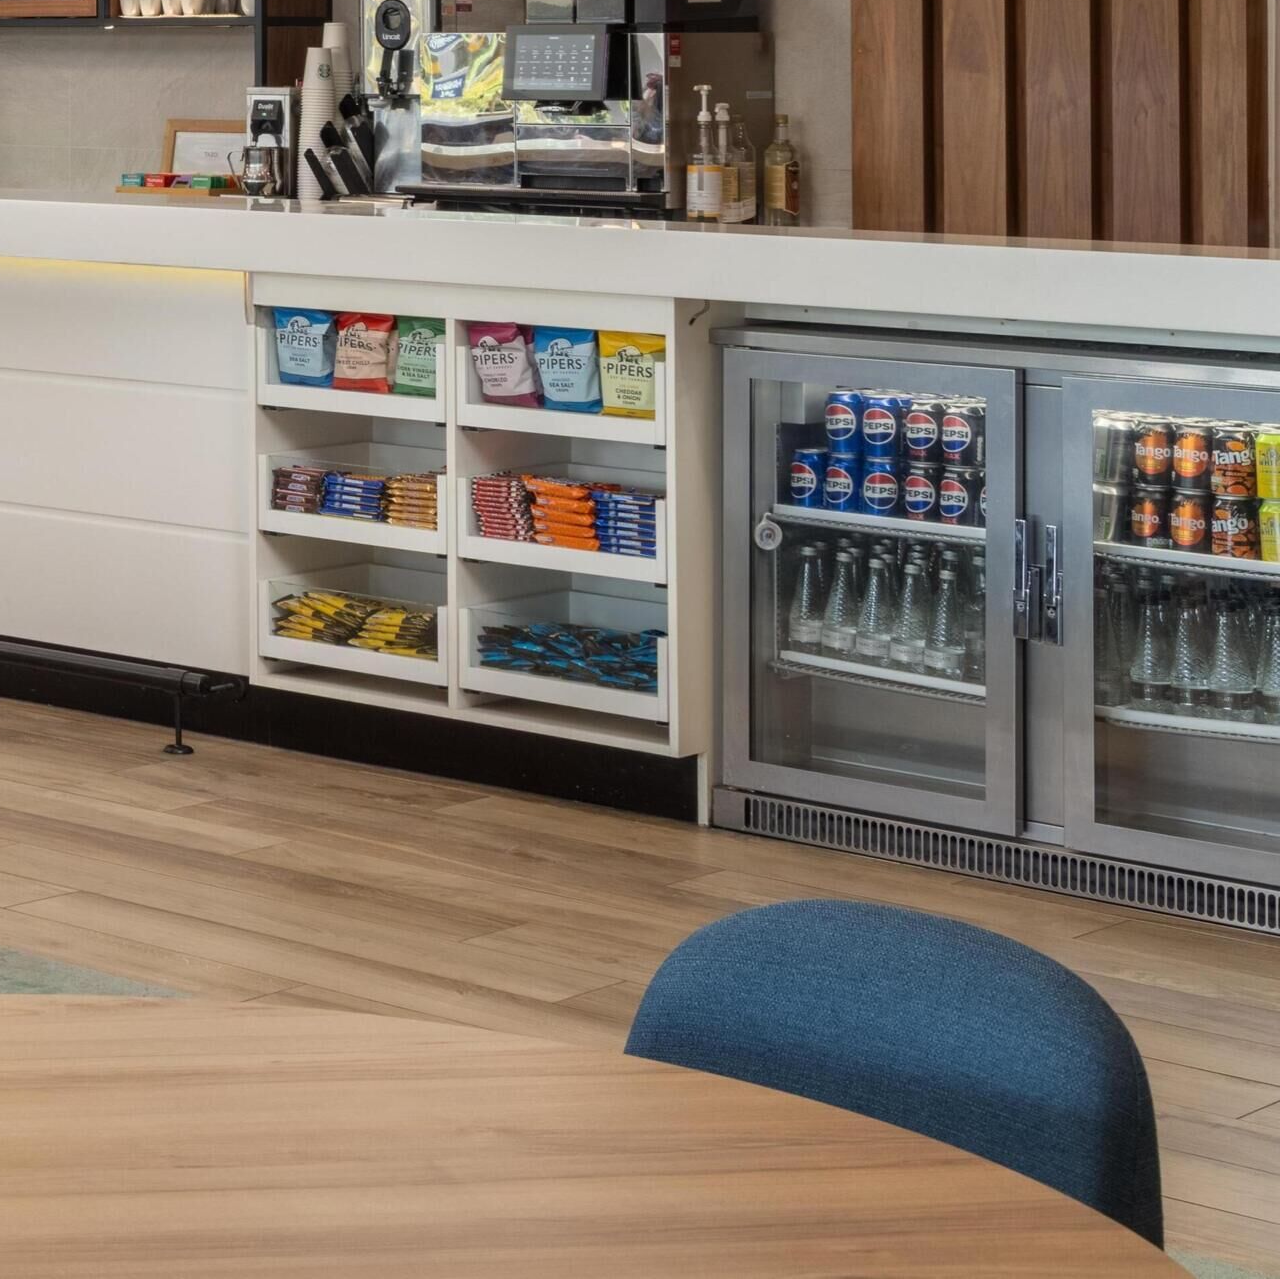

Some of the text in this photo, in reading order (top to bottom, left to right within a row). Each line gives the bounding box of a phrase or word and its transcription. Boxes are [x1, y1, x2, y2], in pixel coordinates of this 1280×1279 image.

[279, 333, 318, 348] PIPERS
[538, 358, 583, 370] PIPERS
[606, 362, 653, 378] PIPERS
[943, 429, 969, 439] EPSI
[1135, 442, 1171, 460] Tango
[792, 475, 814, 485] EPSI
[865, 485, 897, 496] PEPSI
[1211, 516, 1249, 535] ango
